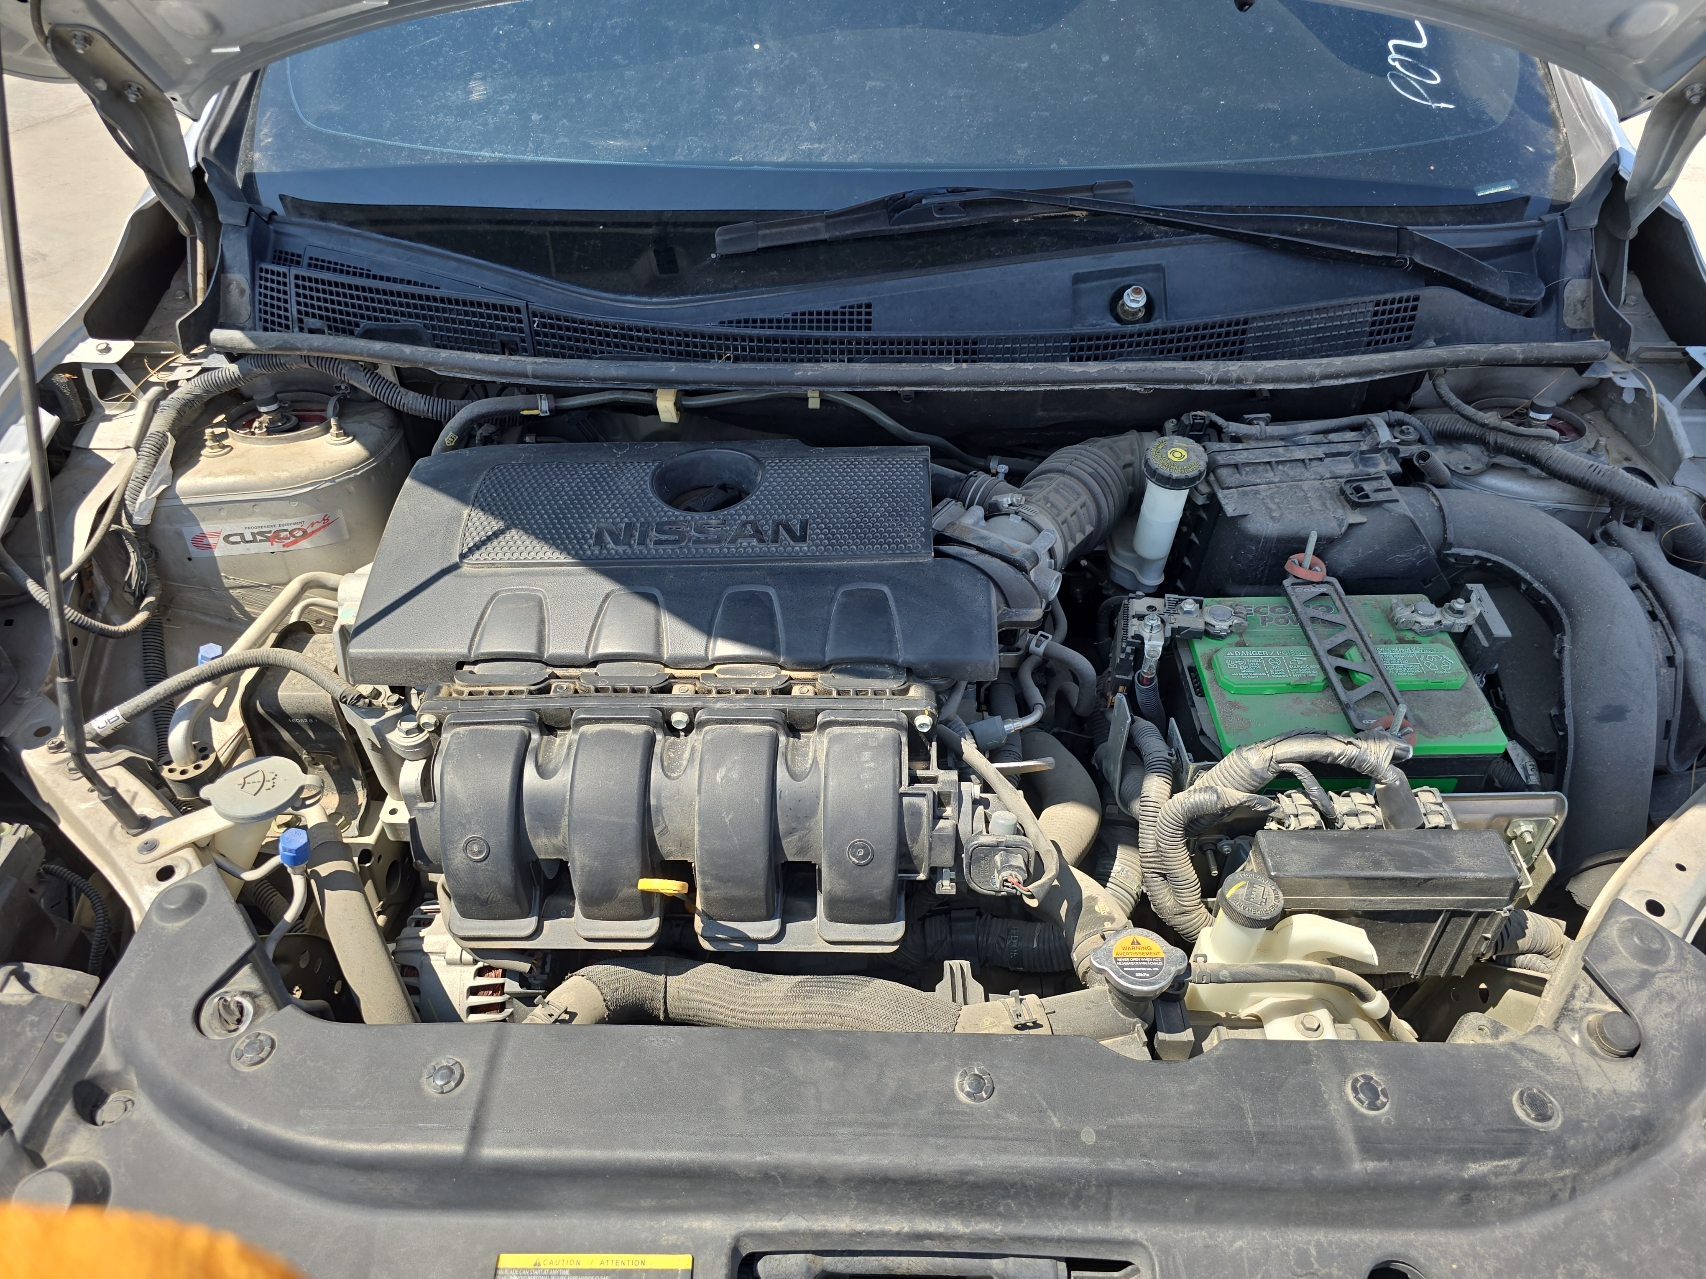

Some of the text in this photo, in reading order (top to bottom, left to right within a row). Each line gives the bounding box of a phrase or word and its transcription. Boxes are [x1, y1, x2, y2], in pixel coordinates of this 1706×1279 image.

[278, 520, 306, 528] EQUIPMENT
[222, 528, 308, 546] CUSCO
[590, 518, 809, 549] NISSAN
[1243, 604, 1335, 616] ECOO
[542, 1258, 581, 1266] CAUTION
[599, 1258, 646, 1267] ATTENTION
